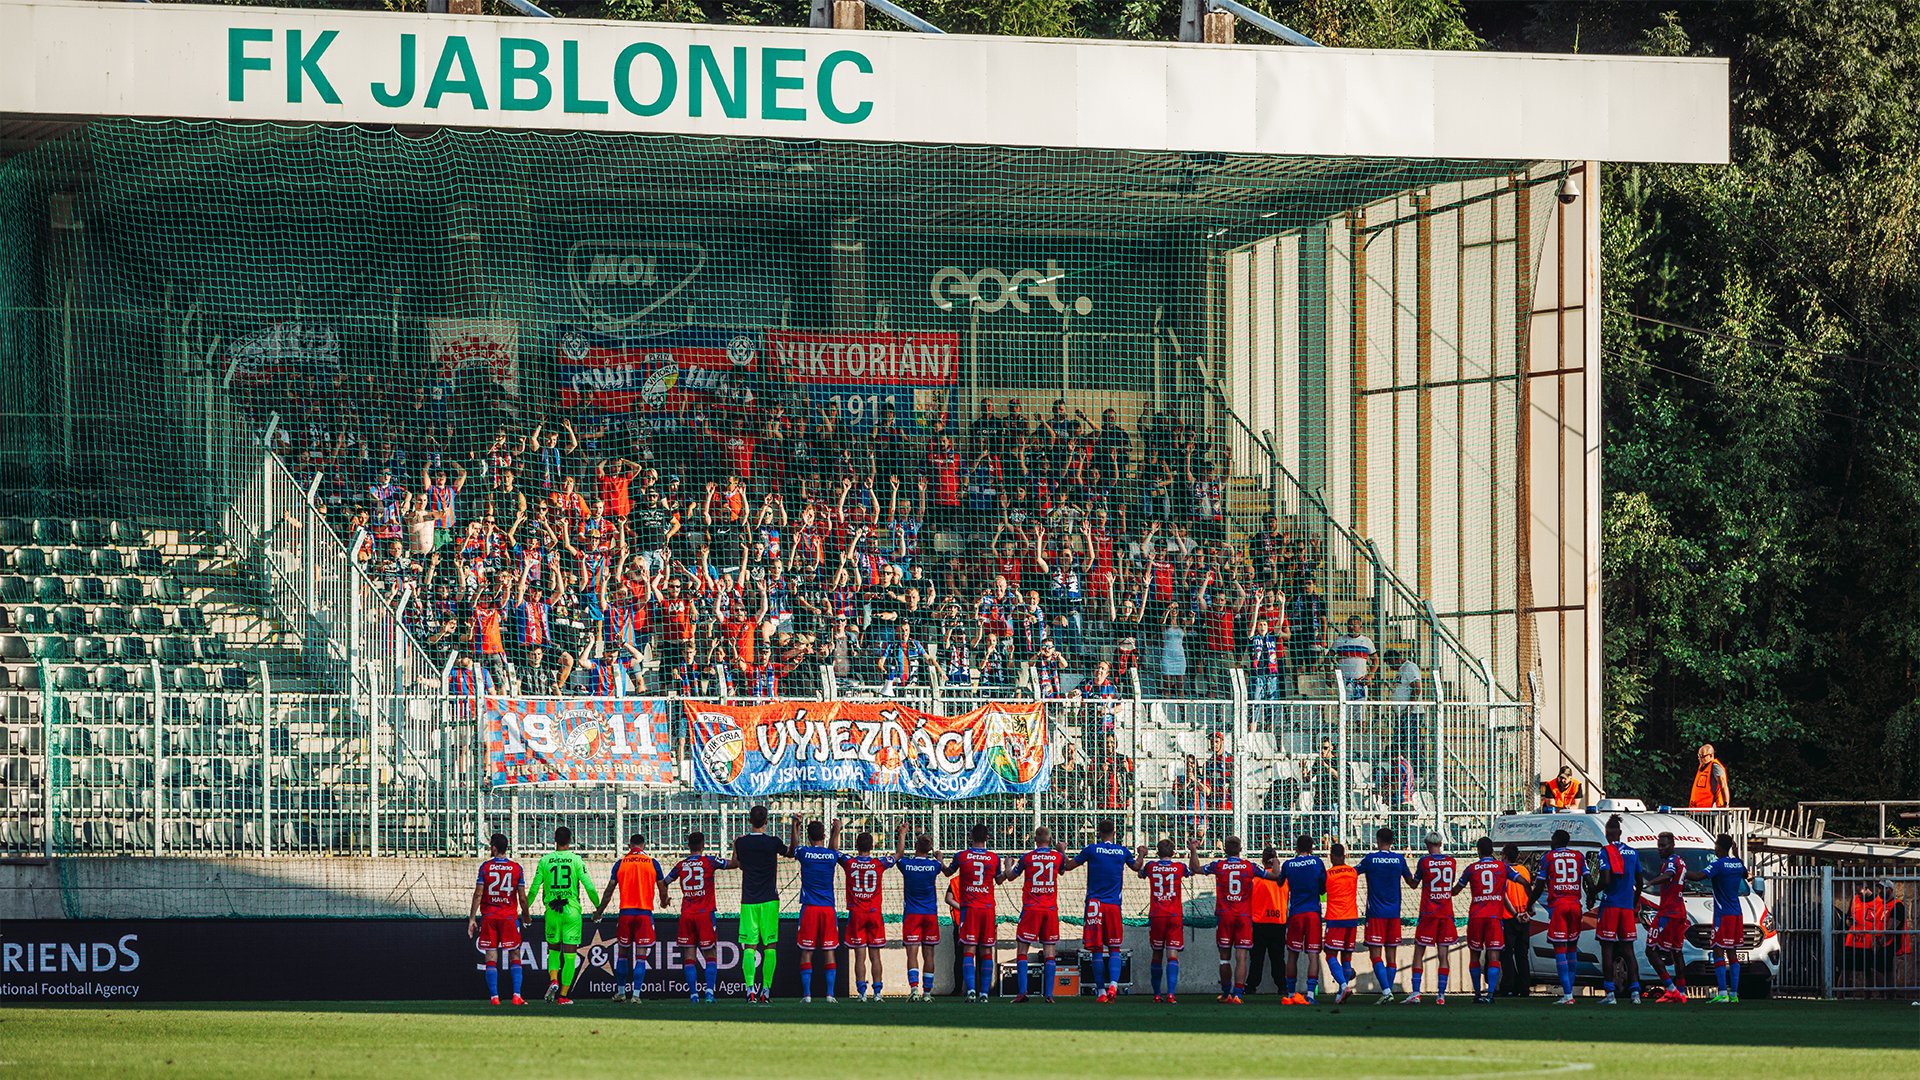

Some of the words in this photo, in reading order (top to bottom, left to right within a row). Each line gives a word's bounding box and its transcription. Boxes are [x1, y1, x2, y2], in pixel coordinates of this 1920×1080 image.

[227, 27, 342, 104] FK
[370, 33, 874, 125] JABLONEC
[588, 254, 656, 285] MOL
[776, 338, 951, 376] VIKTORIÁNI
[500, 712, 559, 755] 19
[607, 712, 657, 755] 11
[708, 732, 740, 751] VIKTORIA
[756, 709, 976, 774] VÝJEZĎÁCI
[778, 766, 817, 784] JSME
[822, 766, 864, 781] DOMA
[1627, 835, 1704, 843] AMBUANCE
[967, 853, 991, 861] Betano
[1096, 847, 1124, 855] macron
[972, 862, 984, 885] 3
[1032, 862, 1054, 885] 21
[1289, 859, 1317, 867] macron
[1555, 858, 1578, 883] 93
[488, 872, 514, 896] 24
[550, 866, 572, 889] 13
[682, 866, 705, 890] 23
[851, 870, 877, 893] 10
[1152, 873, 1176, 896] 31
[1229, 871, 1241, 895] 6
[1430, 867, 1453, 891] 29
[1481, 870, 1493, 895] 9
[0, 981, 38, 996] tional
[42, 982, 92, 995] Football
[95, 983, 139, 998] Agency
[719, 981, 761, 995] Ageny
